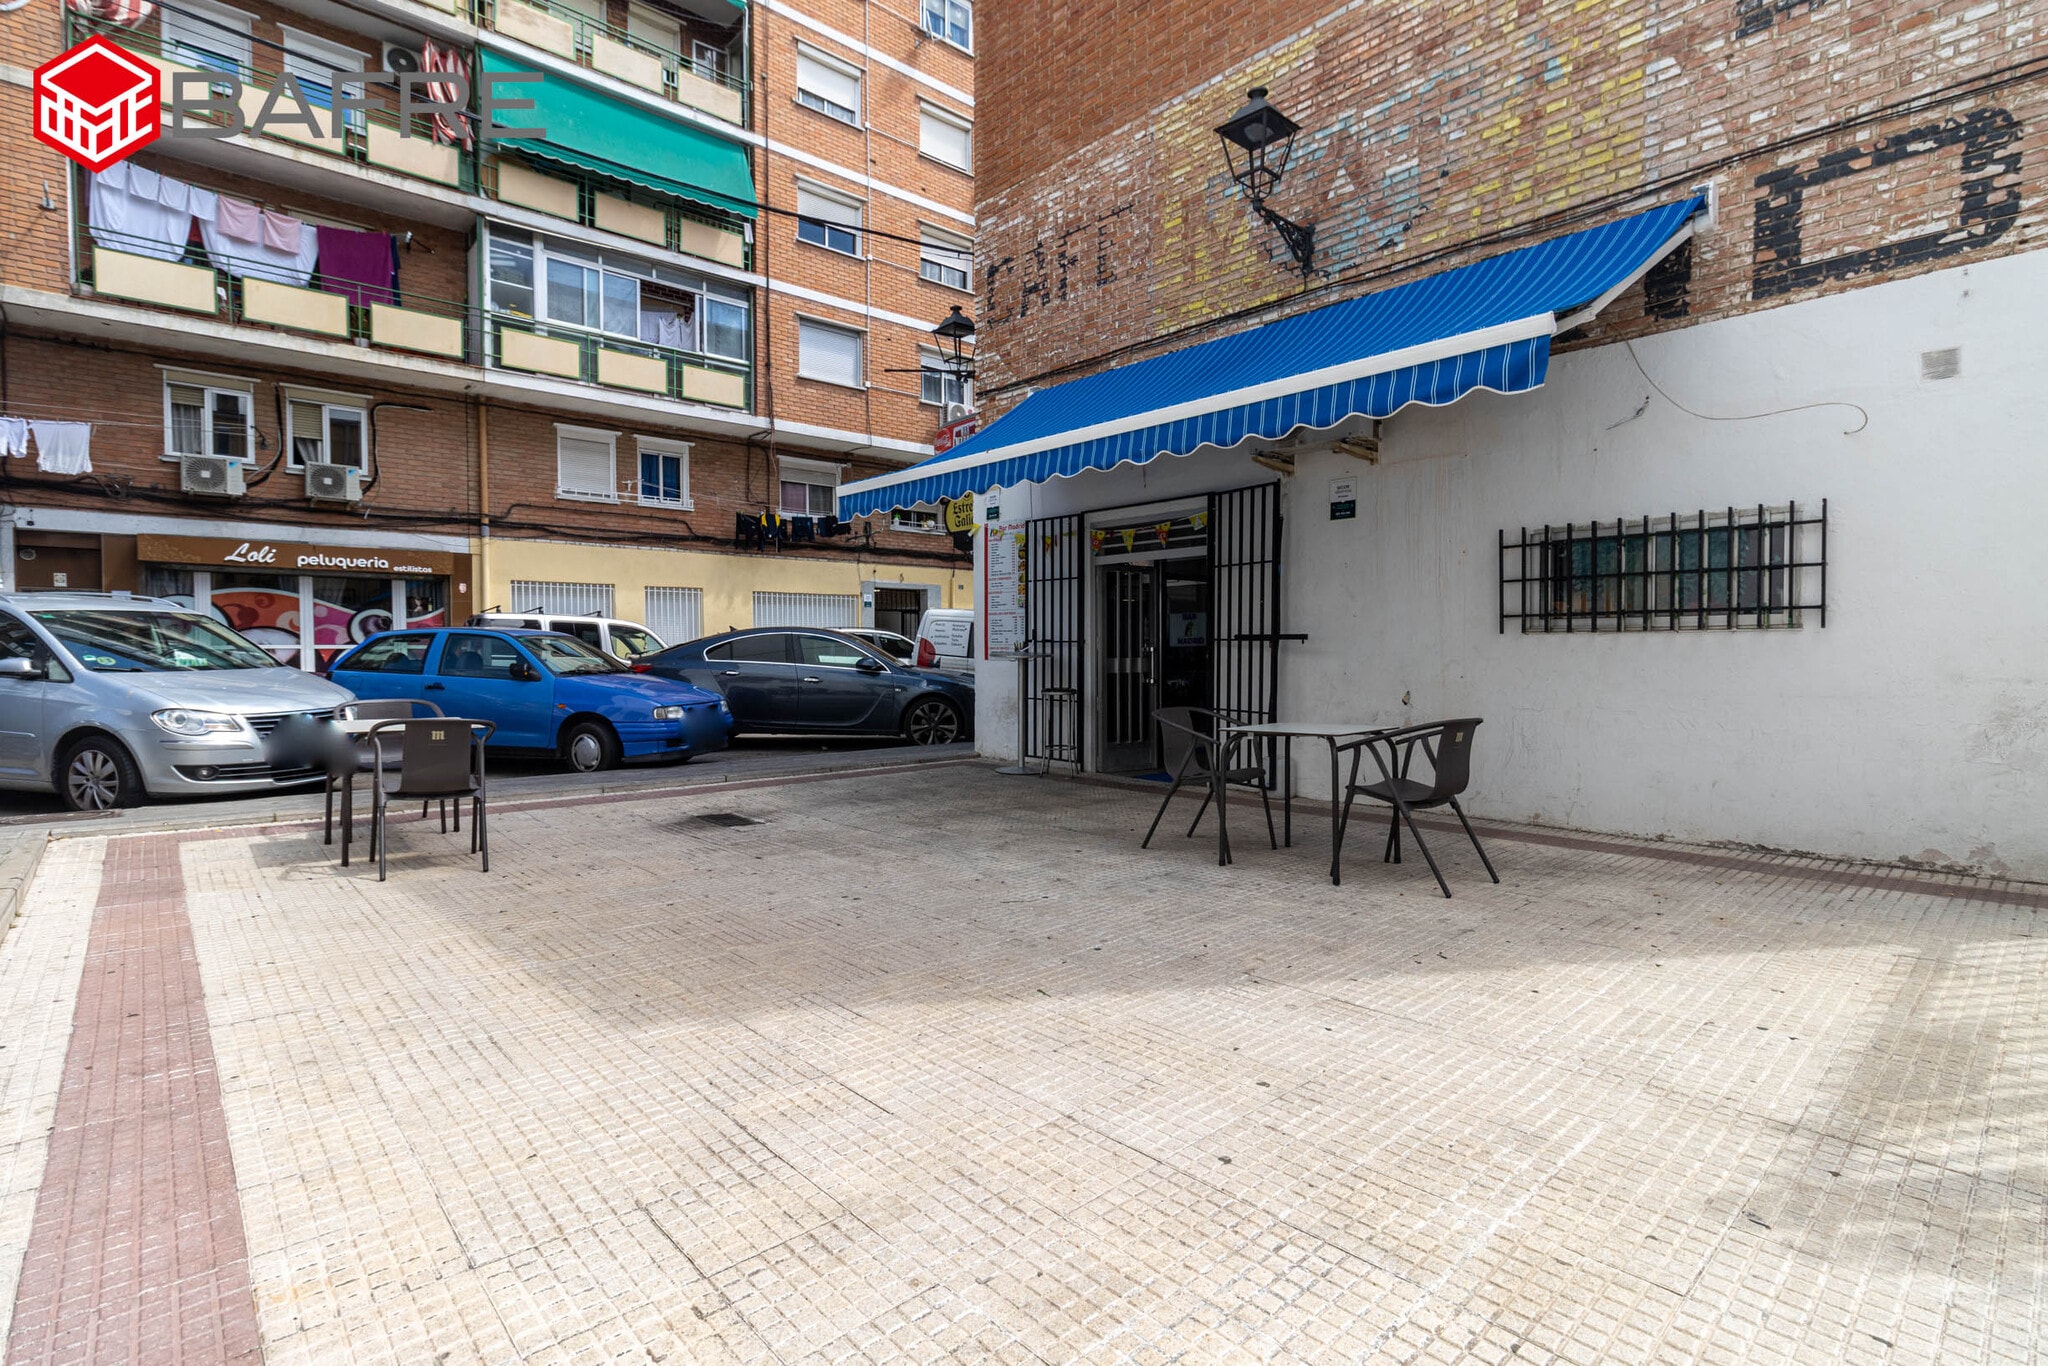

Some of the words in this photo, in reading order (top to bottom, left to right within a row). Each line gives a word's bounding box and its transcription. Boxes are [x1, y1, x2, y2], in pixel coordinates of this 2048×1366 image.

[224, 542, 277, 564] Loli
[297, 553, 389, 569] peluqueria
[393, 565, 433, 573] estilistas
